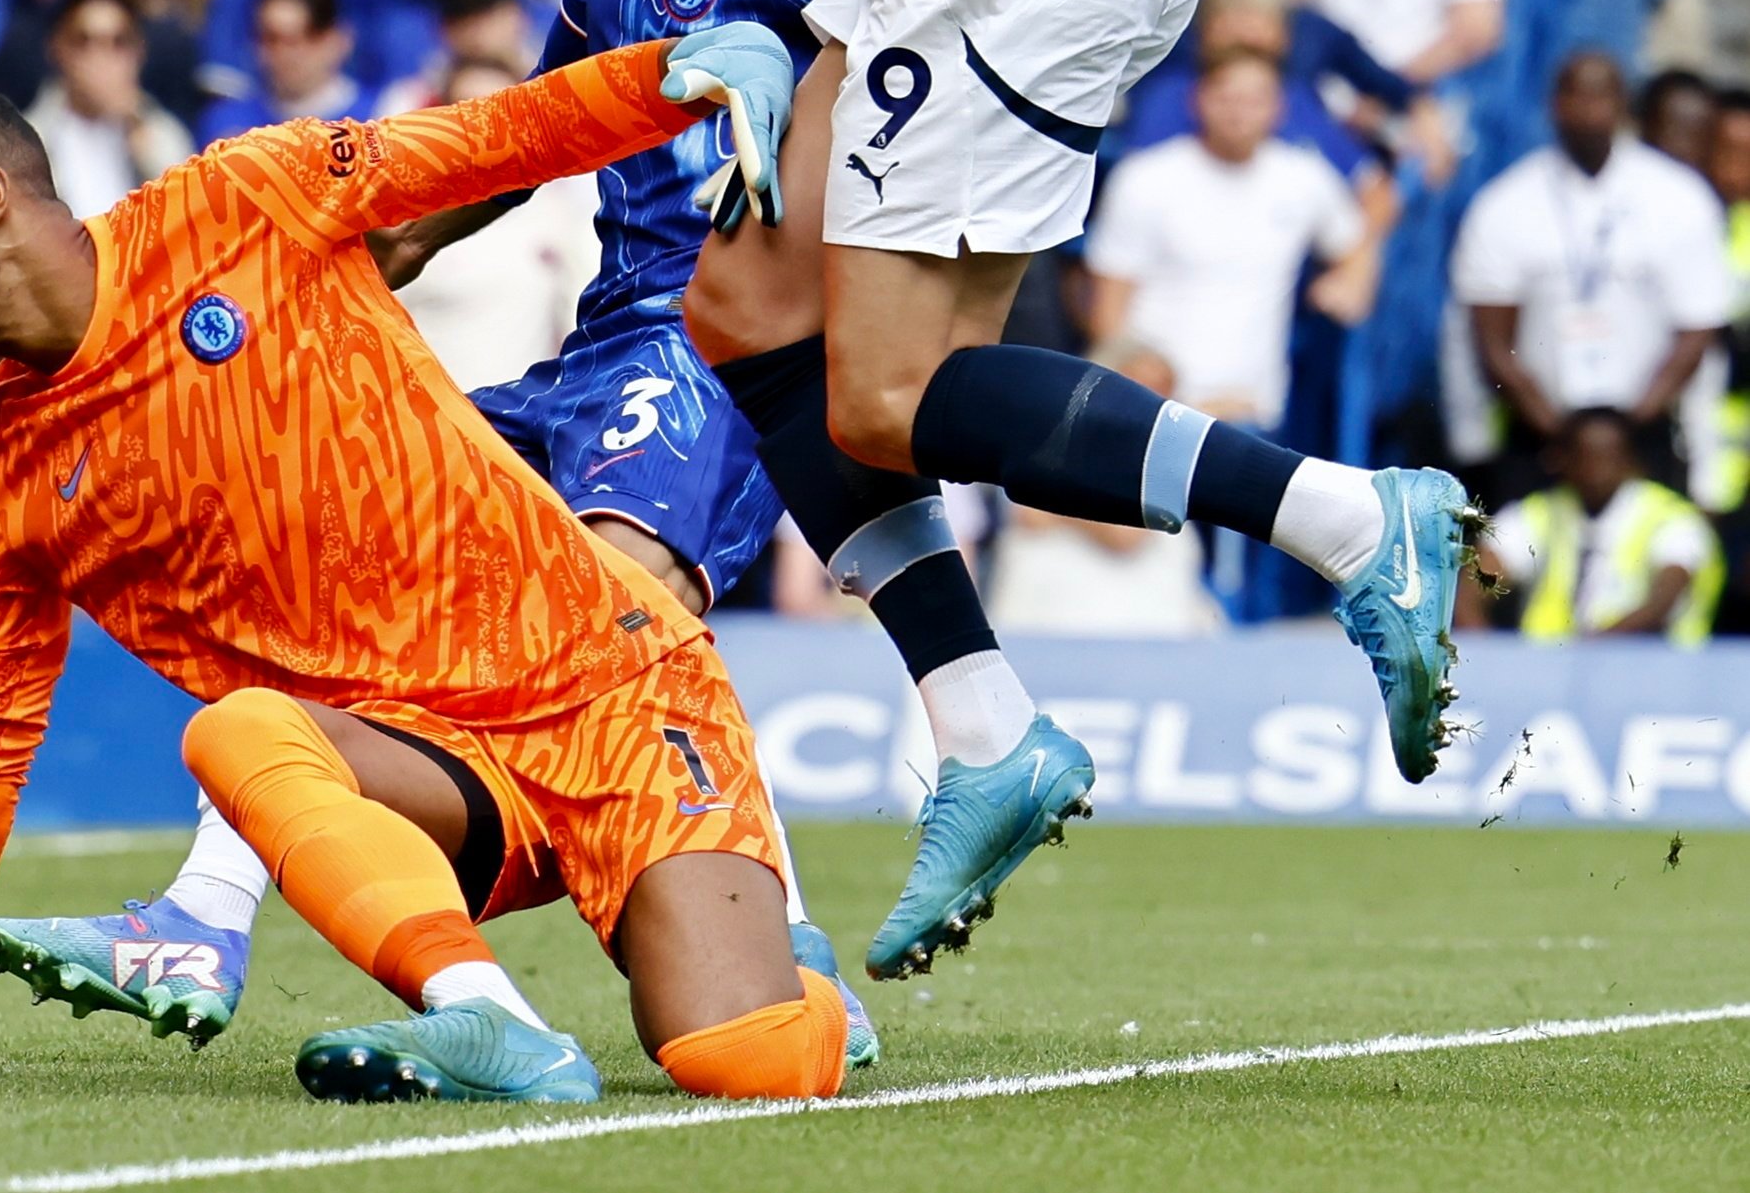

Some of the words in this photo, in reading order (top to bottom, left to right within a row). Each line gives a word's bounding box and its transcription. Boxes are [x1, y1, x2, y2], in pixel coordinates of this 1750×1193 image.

[867, 47, 932, 149] 9
[602, 377, 676, 450] 3
[661, 726, 720, 796] 1
